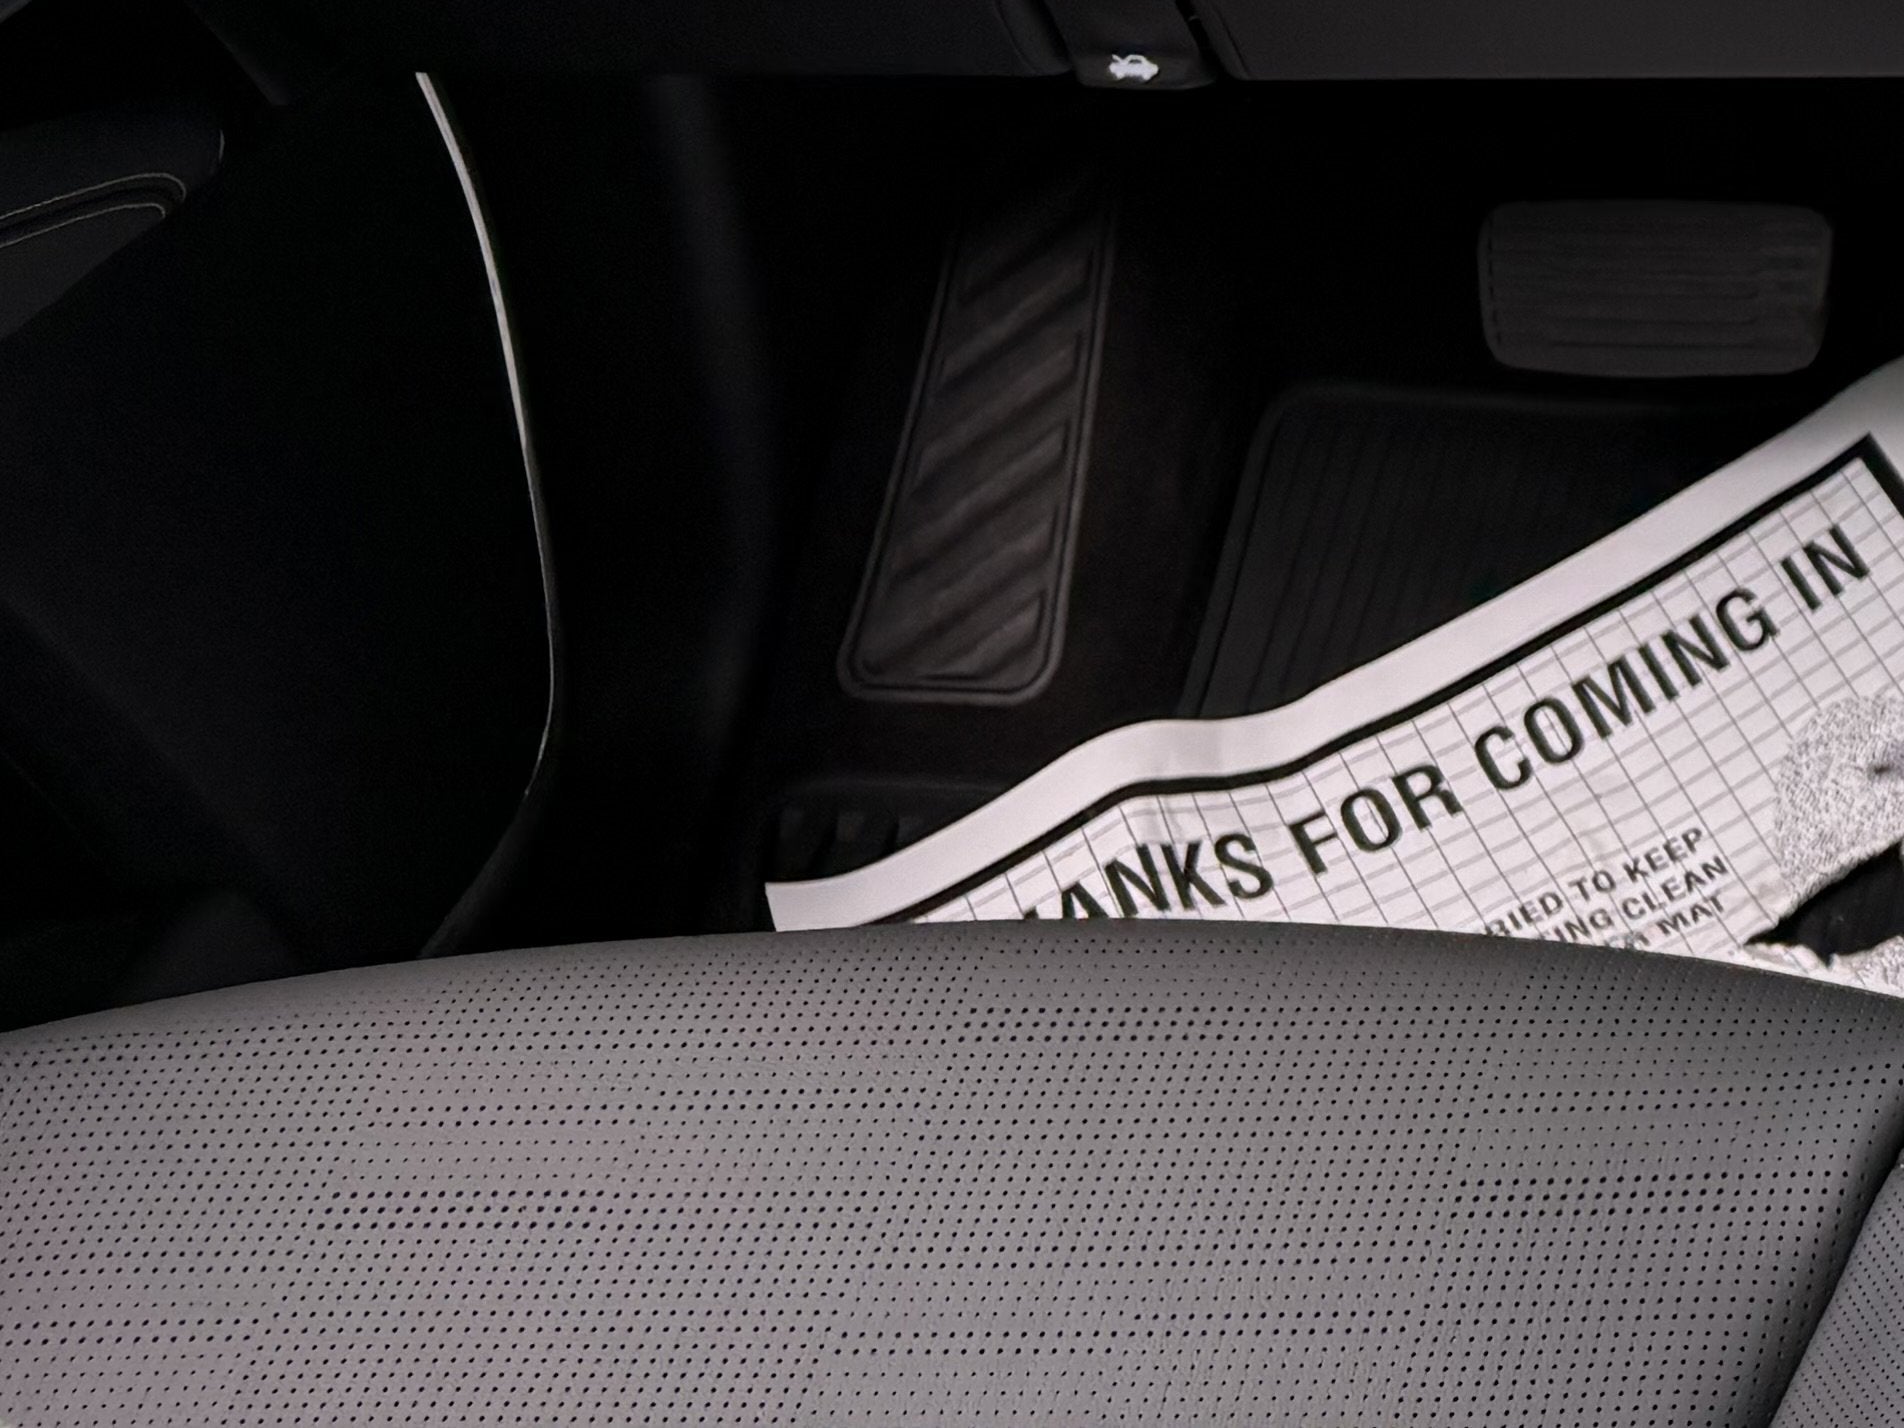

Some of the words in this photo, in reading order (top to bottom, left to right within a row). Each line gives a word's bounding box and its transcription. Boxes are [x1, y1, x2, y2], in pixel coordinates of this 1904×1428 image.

[1022, 832, 1274, 920] ANKS
[1285, 763, 1464, 876] FOR
[1473, 585, 1782, 793] COMING
[1779, 521, 1872, 613] IN
[1484, 890, 1565, 937] RIED
[1567, 869, 1617, 903] TO
[1622, 826, 1705, 884] KEEP
[1538, 907, 1614, 944] ING
[1620, 855, 1731, 922] CLEAN
[1655, 892, 1729, 939] MAT
